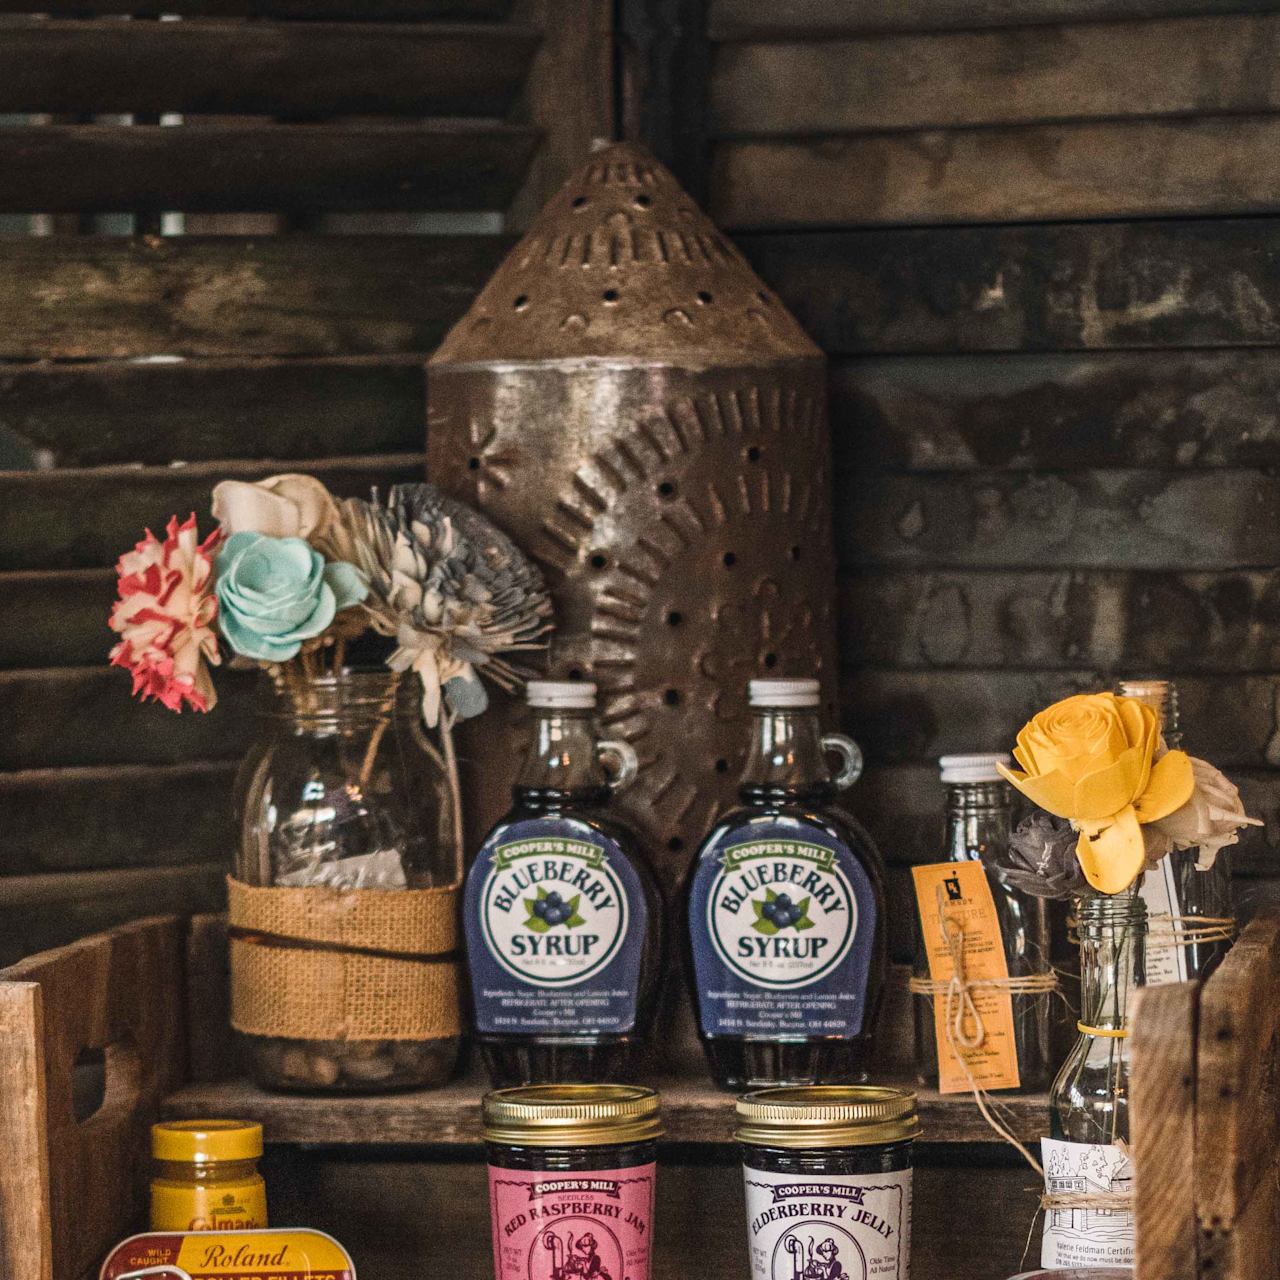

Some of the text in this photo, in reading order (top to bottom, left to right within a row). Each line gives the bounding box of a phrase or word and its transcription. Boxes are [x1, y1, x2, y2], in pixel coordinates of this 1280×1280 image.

[503, 842, 597, 857] COOPER'S MILL
[732, 845, 828, 861] COOPER'S MILL
[494, 860, 616, 913] BLUEBERRY
[721, 863, 845, 915] BLUEBERRY
[511, 934, 599, 956] SYRUP
[737, 937, 828, 958] SYRUP
[535, 1181, 615, 1193] COOPER'S MILL
[778, 1186, 859, 1197] COOPER'S MILL
[504, 1203, 647, 1237] RED RASPBERRY JAM
[752, 1203, 894, 1239] ELDERBERRY JELLY
[147, 1249, 171, 1257] WILD
[199, 1244, 288, 1268] Roland
[1075, 1245, 1105, 1254] Feldman
[130, 1256, 169, 1265] CAUGHT
